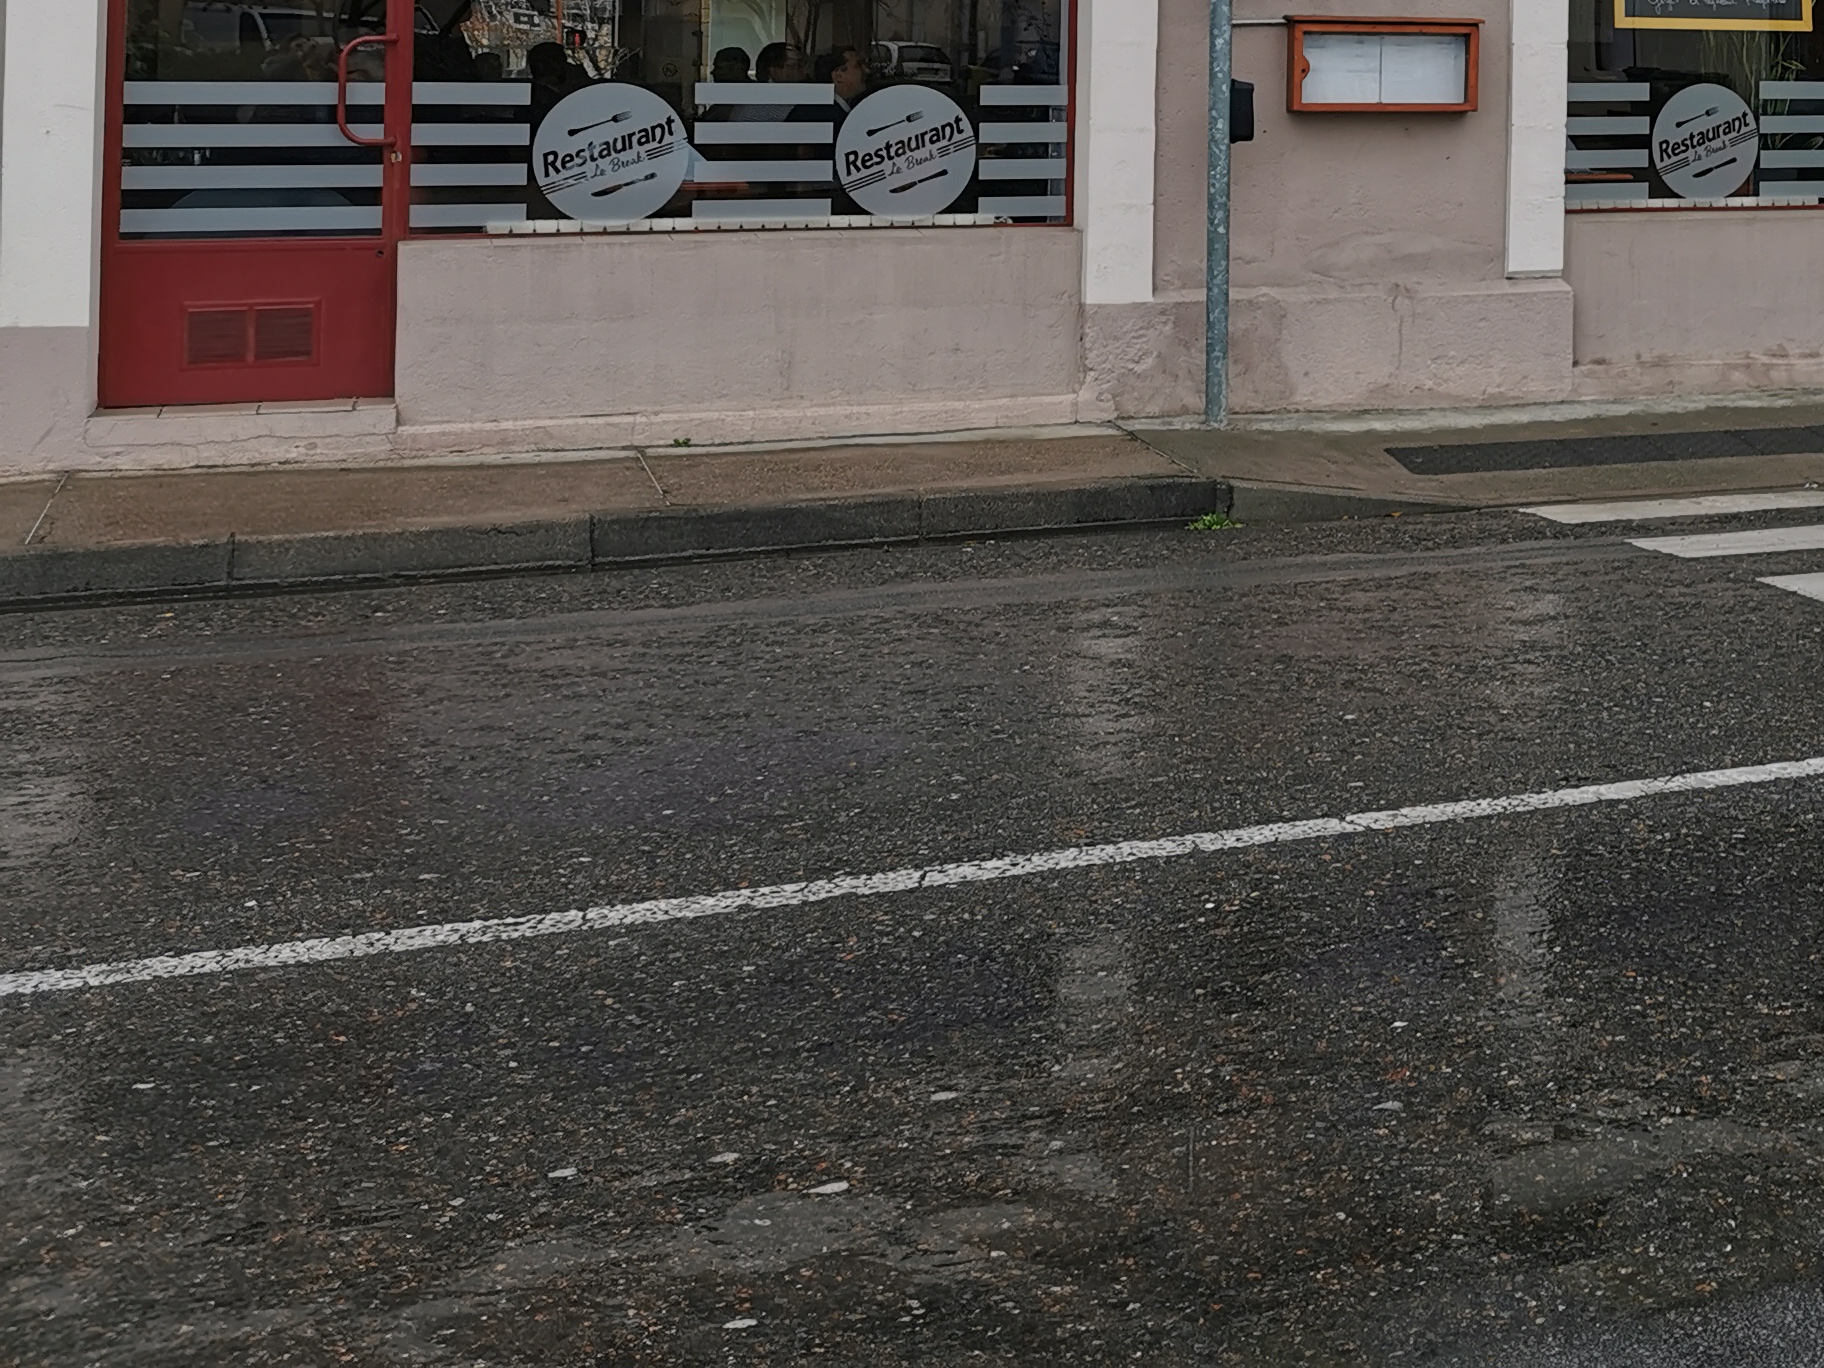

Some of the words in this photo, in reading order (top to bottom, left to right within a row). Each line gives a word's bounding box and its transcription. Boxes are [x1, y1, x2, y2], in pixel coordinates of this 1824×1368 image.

[542, 115, 676, 178] Restaurant
[609, 151, 645, 173] Break
[844, 114, 965, 177] Restaurant
[1658, 110, 1750, 163] Restaurant
